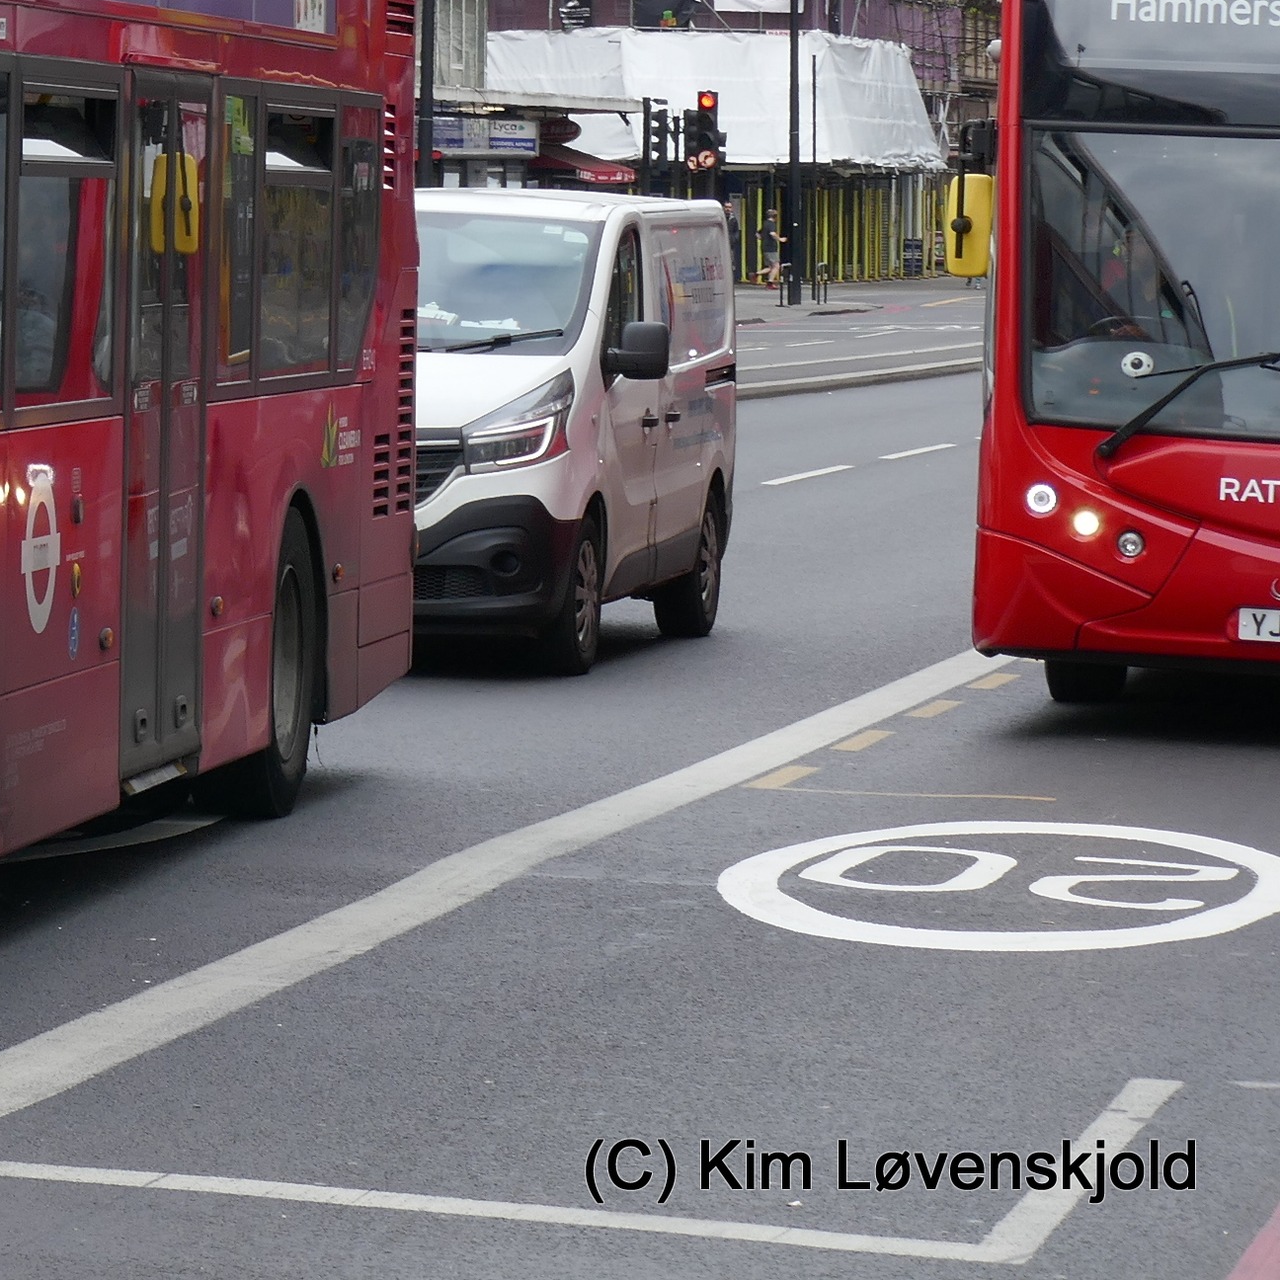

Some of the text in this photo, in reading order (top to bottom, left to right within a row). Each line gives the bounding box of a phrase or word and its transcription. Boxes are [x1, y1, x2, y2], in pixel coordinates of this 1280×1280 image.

[493, 121, 518, 132] Lyca
[1219, 477, 1280, 504] RAT
[798, 845, 1240, 911] 20
